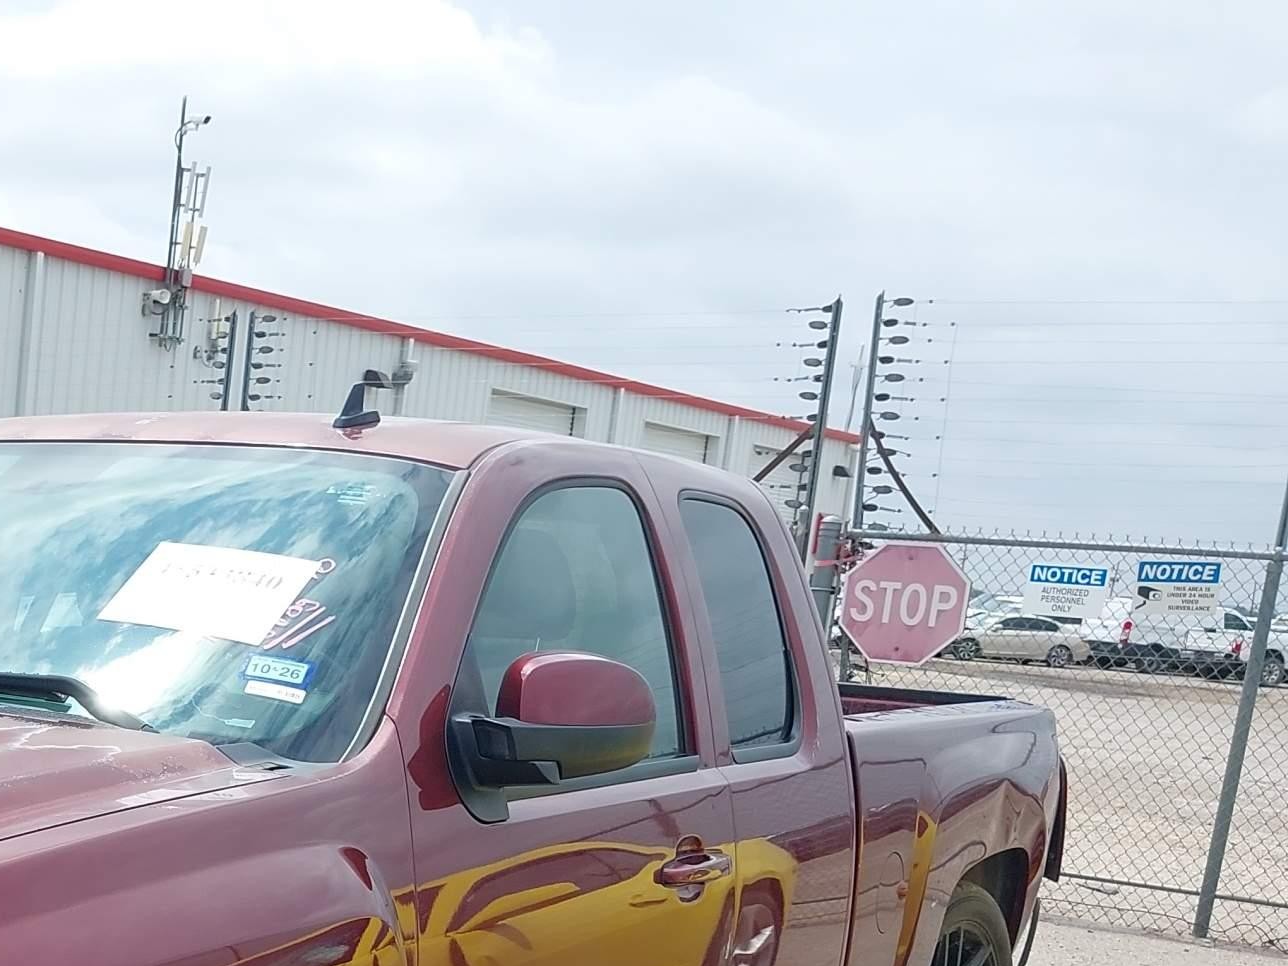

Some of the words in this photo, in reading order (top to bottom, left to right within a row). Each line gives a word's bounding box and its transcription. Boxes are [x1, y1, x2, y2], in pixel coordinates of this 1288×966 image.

[1033, 566, 1104, 585] NOTICE
[1140, 563, 1218, 581] NOTICE
[1041, 586, 1090, 598] AUTHORIZED
[849, 579, 958, 628] STOP
[1040, 594, 1087, 606] PERSONNEL
[1051, 604, 1072, 613] ONLY
